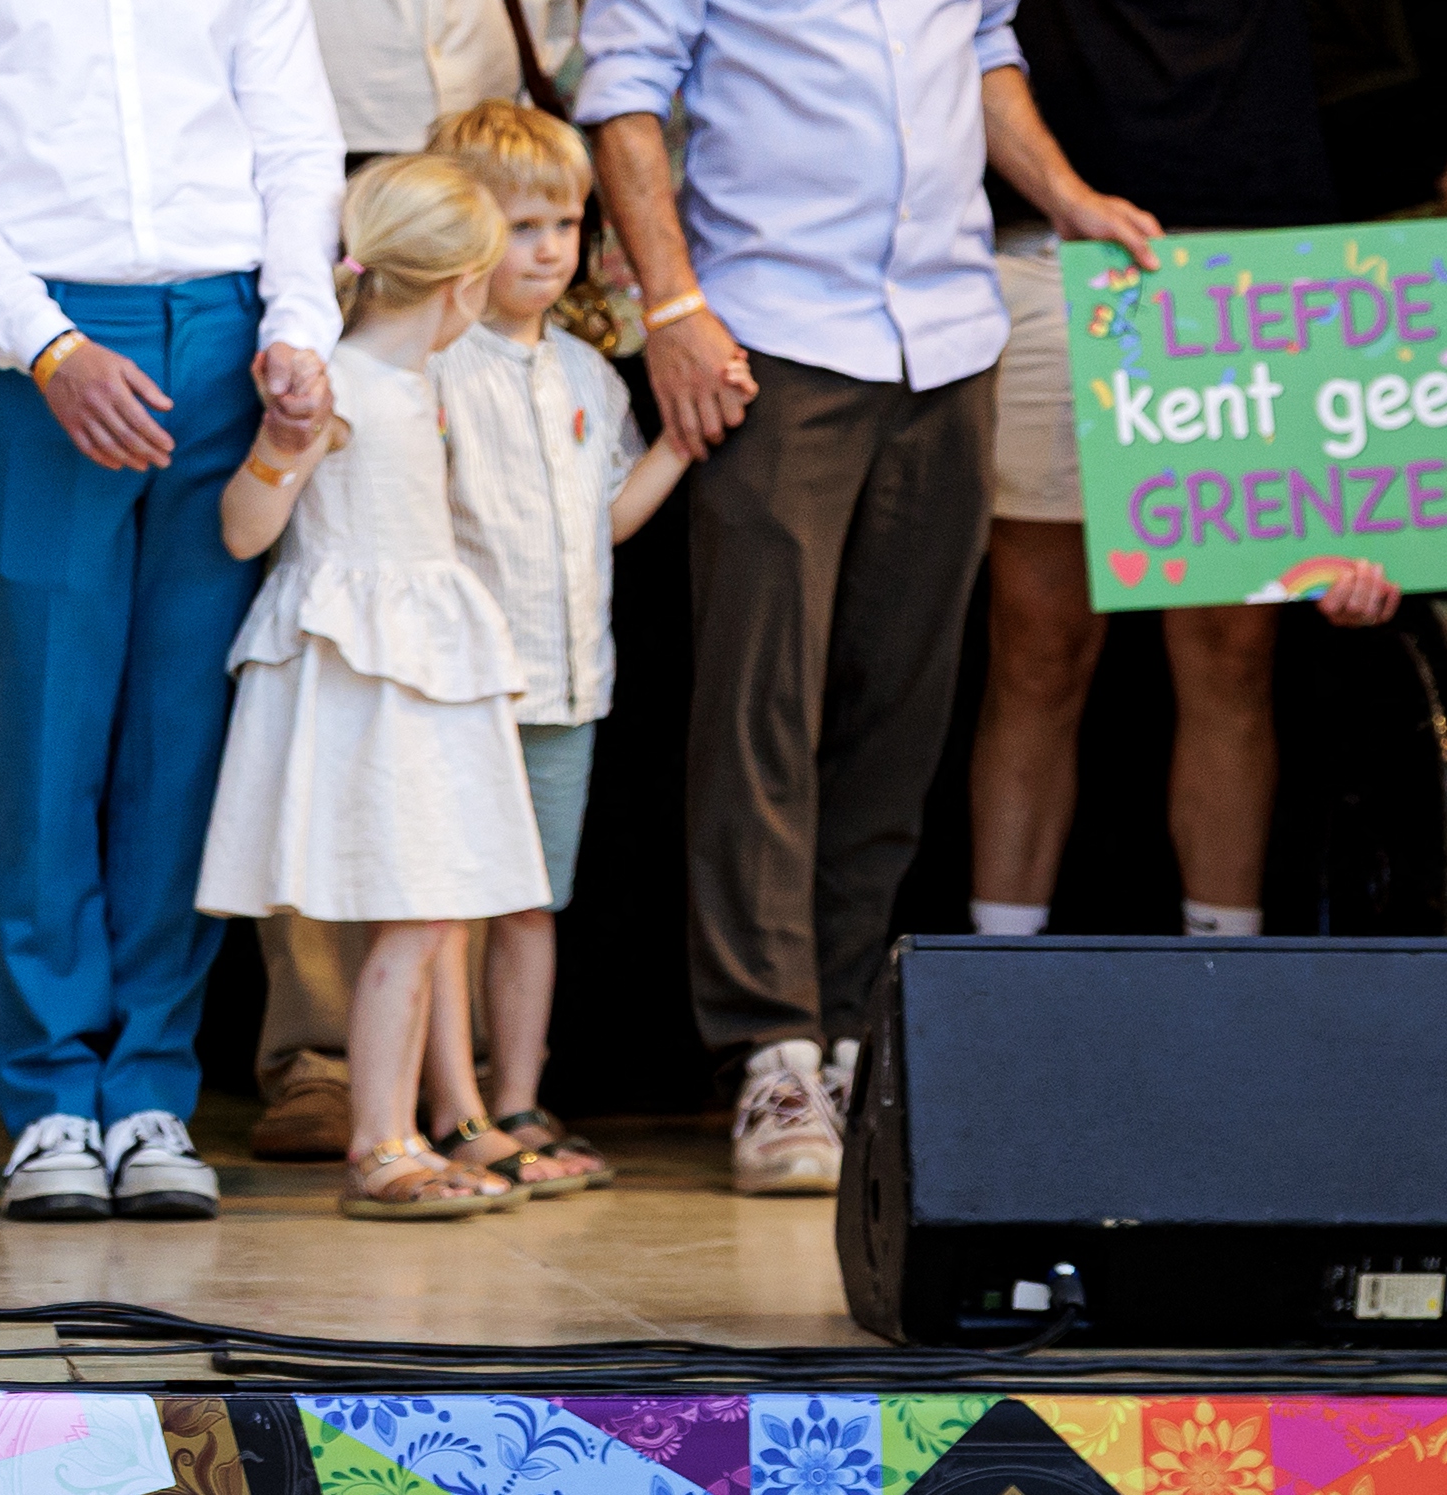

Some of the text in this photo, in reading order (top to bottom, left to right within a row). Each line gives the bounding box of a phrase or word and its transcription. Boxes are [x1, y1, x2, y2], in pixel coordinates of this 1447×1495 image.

[1159, 275, 1437, 357] LIEFDE
[1113, 361, 1447, 459] kent gee
[1129, 459, 1447, 548] GRENZE
